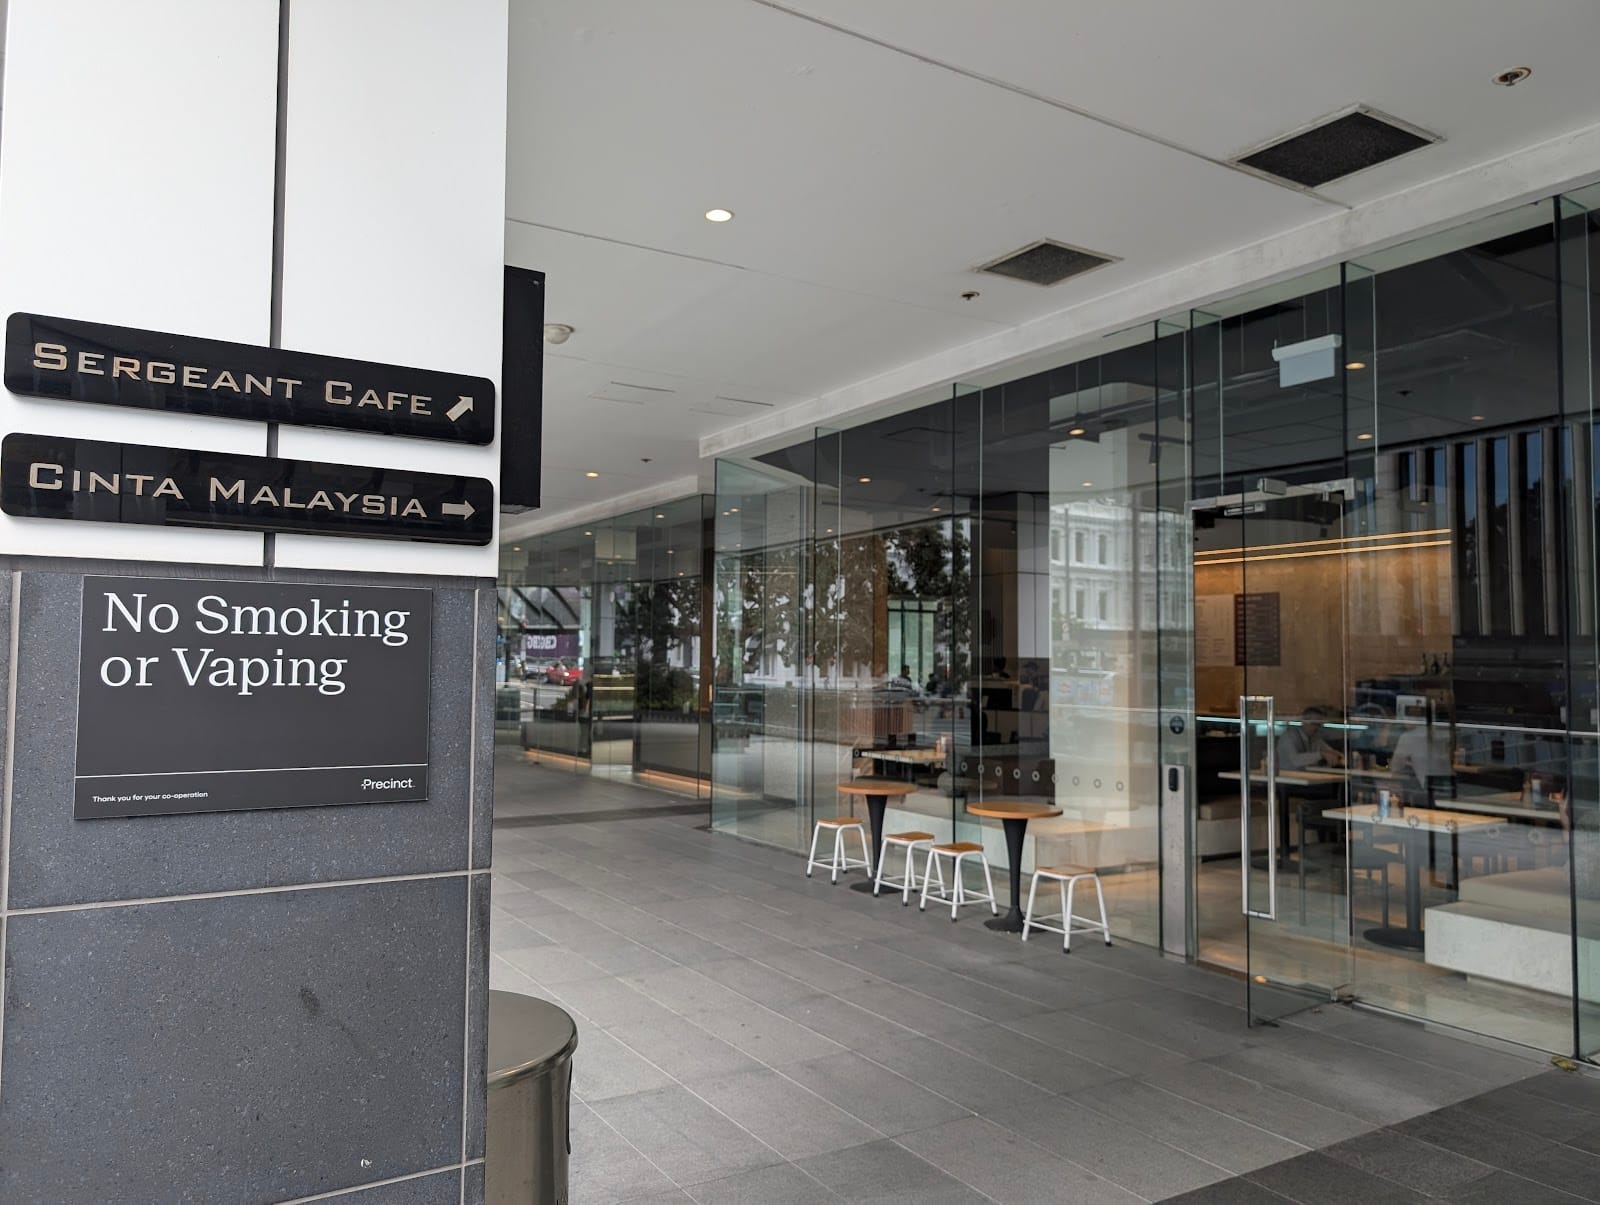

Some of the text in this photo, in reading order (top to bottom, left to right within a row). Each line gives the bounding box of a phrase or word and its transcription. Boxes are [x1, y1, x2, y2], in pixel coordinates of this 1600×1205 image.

[33, 342, 433, 416] SERGEANT CAFE
[29, 462, 428, 519] CINTA MALAYSIA
[102, 592, 411, 647] No Smoking
[100, 647, 348, 696] or Vaping
[92, 795, 116, 803] Thank
[117, 795, 131, 803] you
[144, 793, 161, 802] your
[162, 791, 209, 800] co-operation
[361, 777, 414, 790] Precinct
